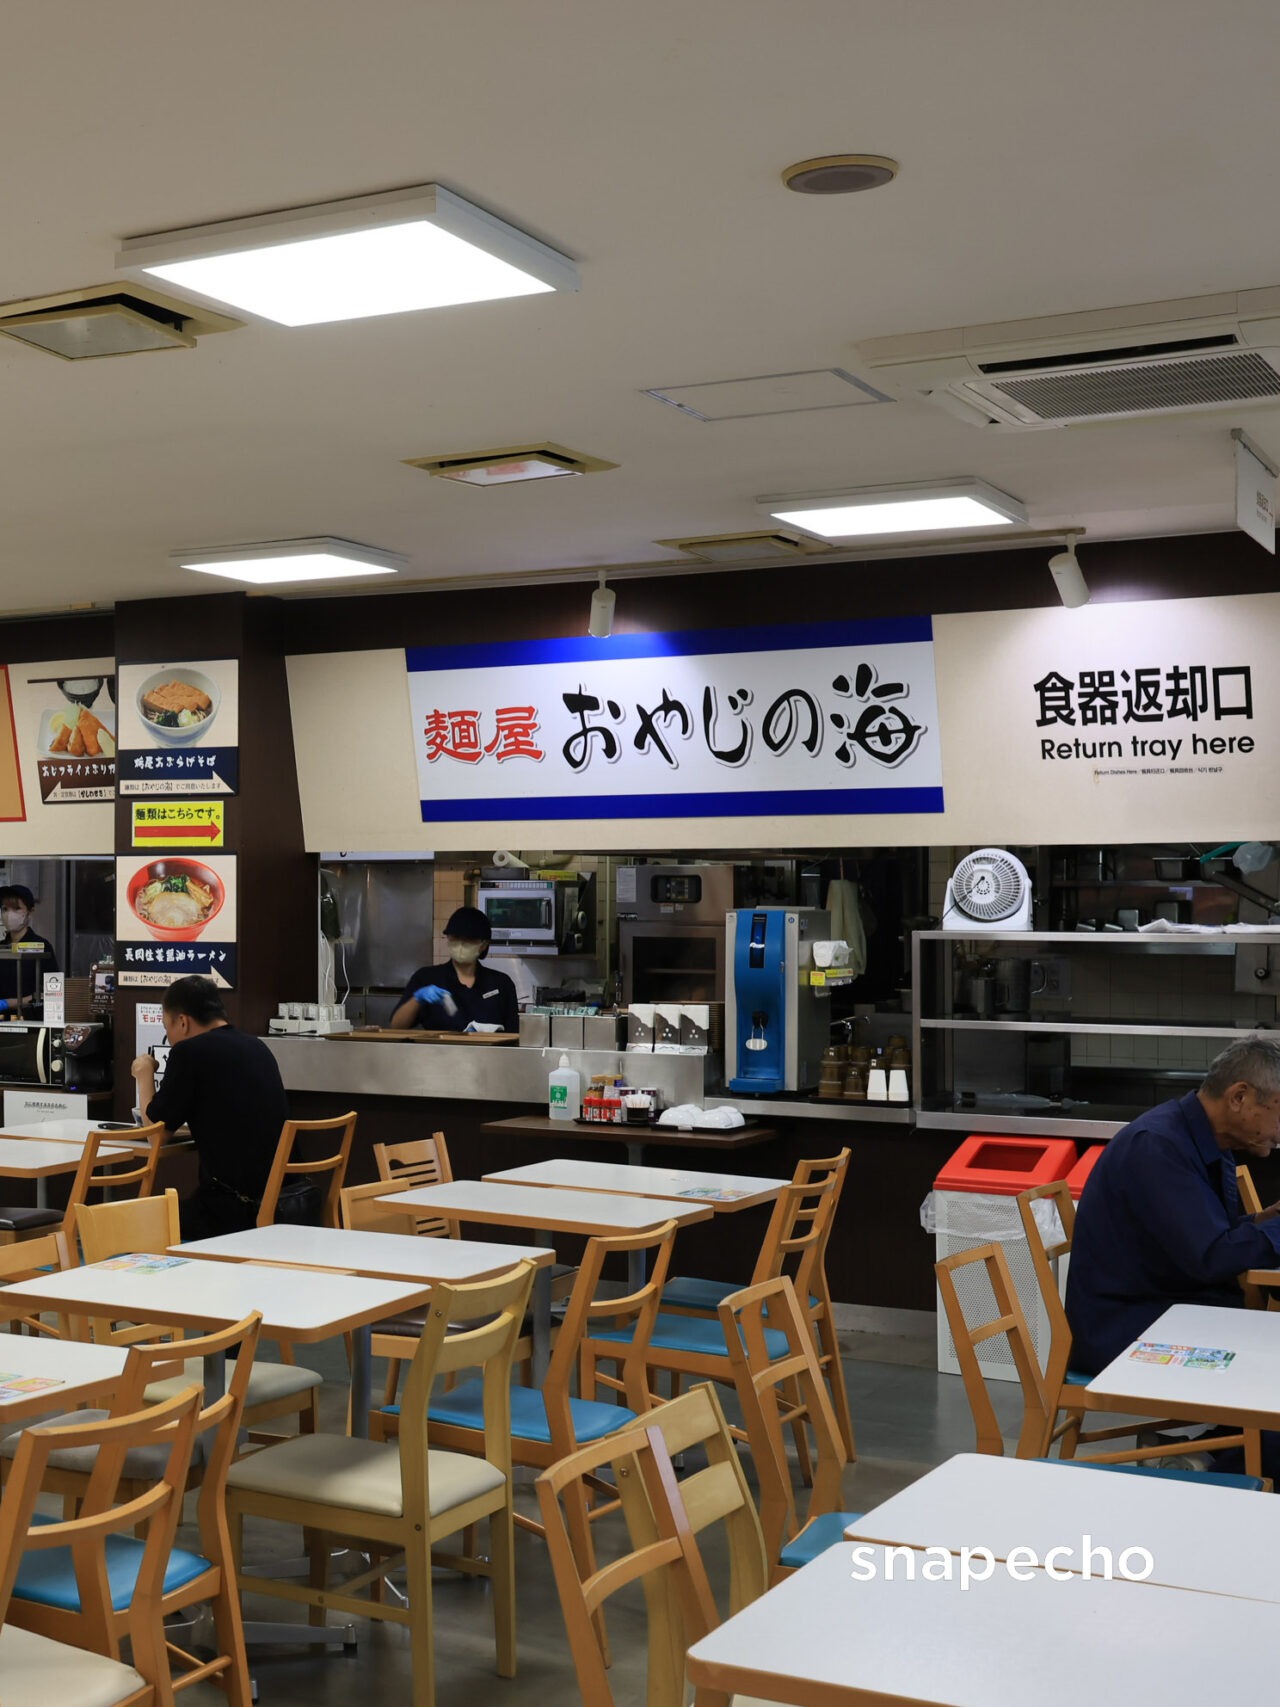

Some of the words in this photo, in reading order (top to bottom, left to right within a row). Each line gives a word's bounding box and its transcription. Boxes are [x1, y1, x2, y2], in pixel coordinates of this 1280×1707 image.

[423, 704, 544, 764] 麺屋
[561, 661, 927, 773] おやじの海
[1033, 665, 1254, 728] 食器返却口
[1041, 736, 1123, 760] Return
[1131, 734, 1183, 760] tray
[1192, 733, 1255, 755] here
[135, 807, 221, 821] 麺類はこちらです。
